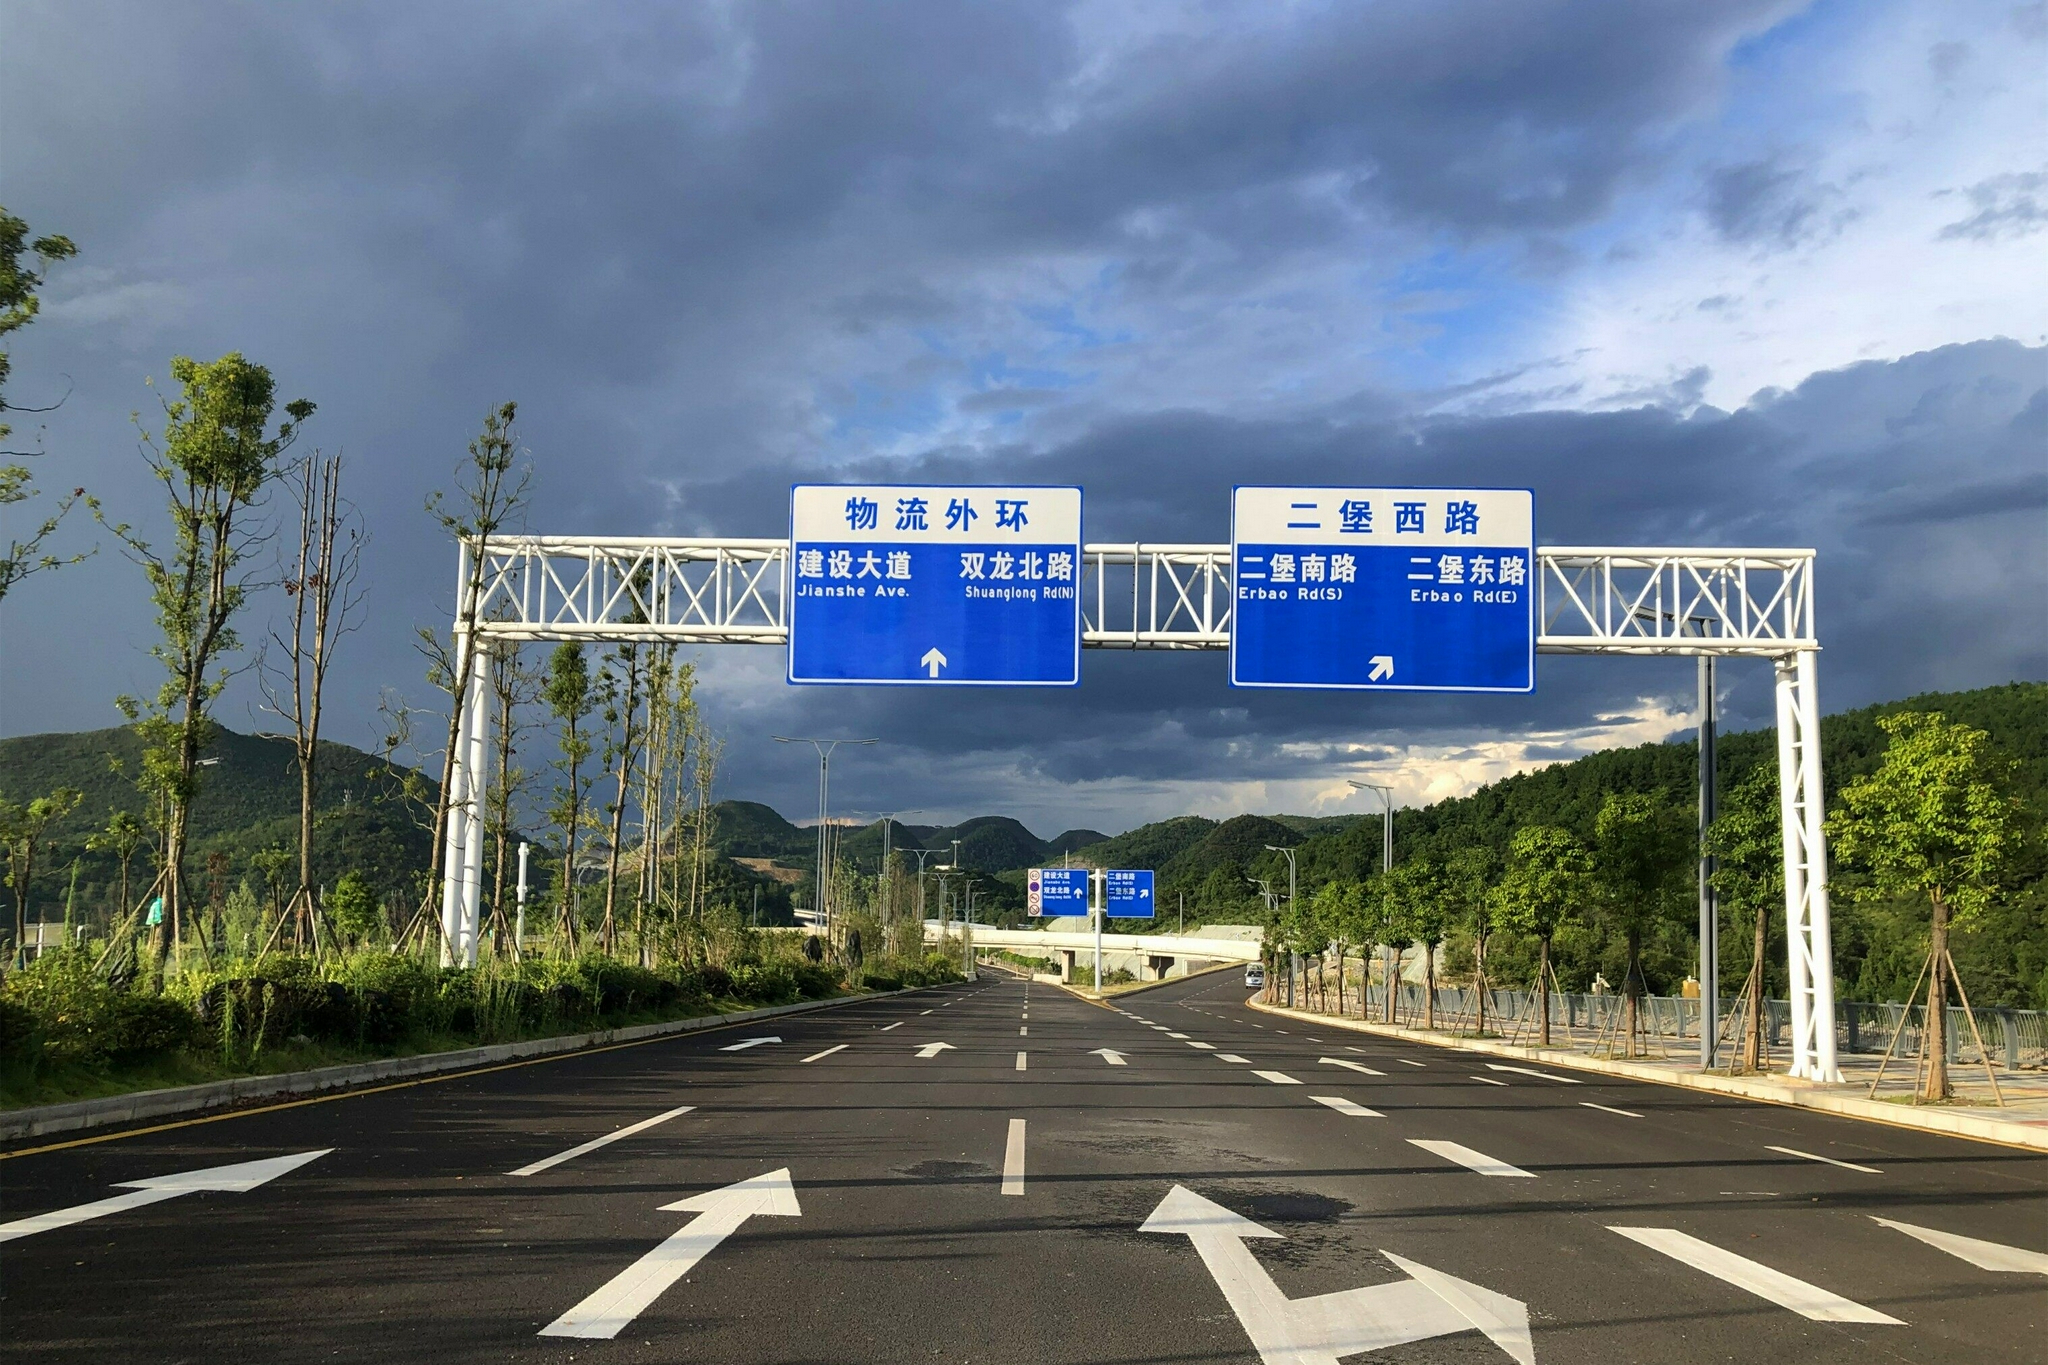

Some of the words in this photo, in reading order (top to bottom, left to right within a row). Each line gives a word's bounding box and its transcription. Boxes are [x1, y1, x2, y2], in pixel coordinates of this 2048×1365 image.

[845, 497, 1029, 532] 物流外环
[1287, 499, 1480, 535] 二堡西路
[798, 549, 912, 580] 建设大道
[959, 551, 1074, 581] 双龙北路
[1240, 553, 1357, 583] 二堡南路
[1407, 554, 1527, 586] 二堡东路
[797, 584, 866, 597] Jianshe
[874, 584, 910, 597] Ave.
[965, 586, 1037, 602] Shuanglong
[1043, 586, 1074, 599] Rd(N)
[1239, 587, 1288, 600] Erbao
[1298, 587, 1343, 600] Rd(S)
[1411, 589, 1463, 602] Erbao
[1473, 590, 1517, 603] Rd(E)
